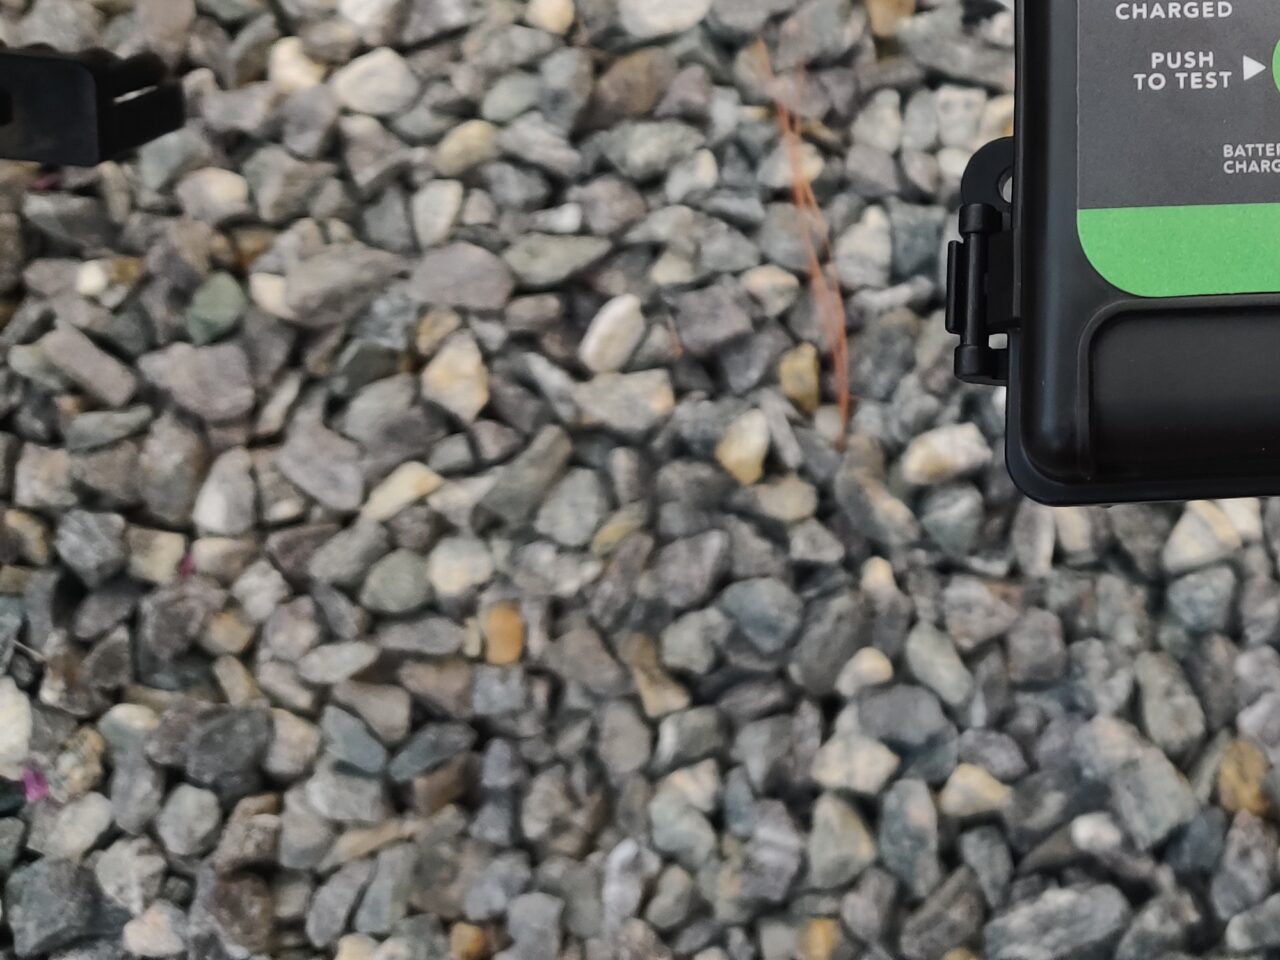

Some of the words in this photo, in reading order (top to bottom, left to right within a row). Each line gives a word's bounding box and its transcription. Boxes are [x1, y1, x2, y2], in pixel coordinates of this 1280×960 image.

[1115, 1, 1233, 20] CHARGED
[1151, 52, 1214, 69] PUSH
[1133, 74, 1166, 91] TO
[1175, 72, 1232, 89] TEST
